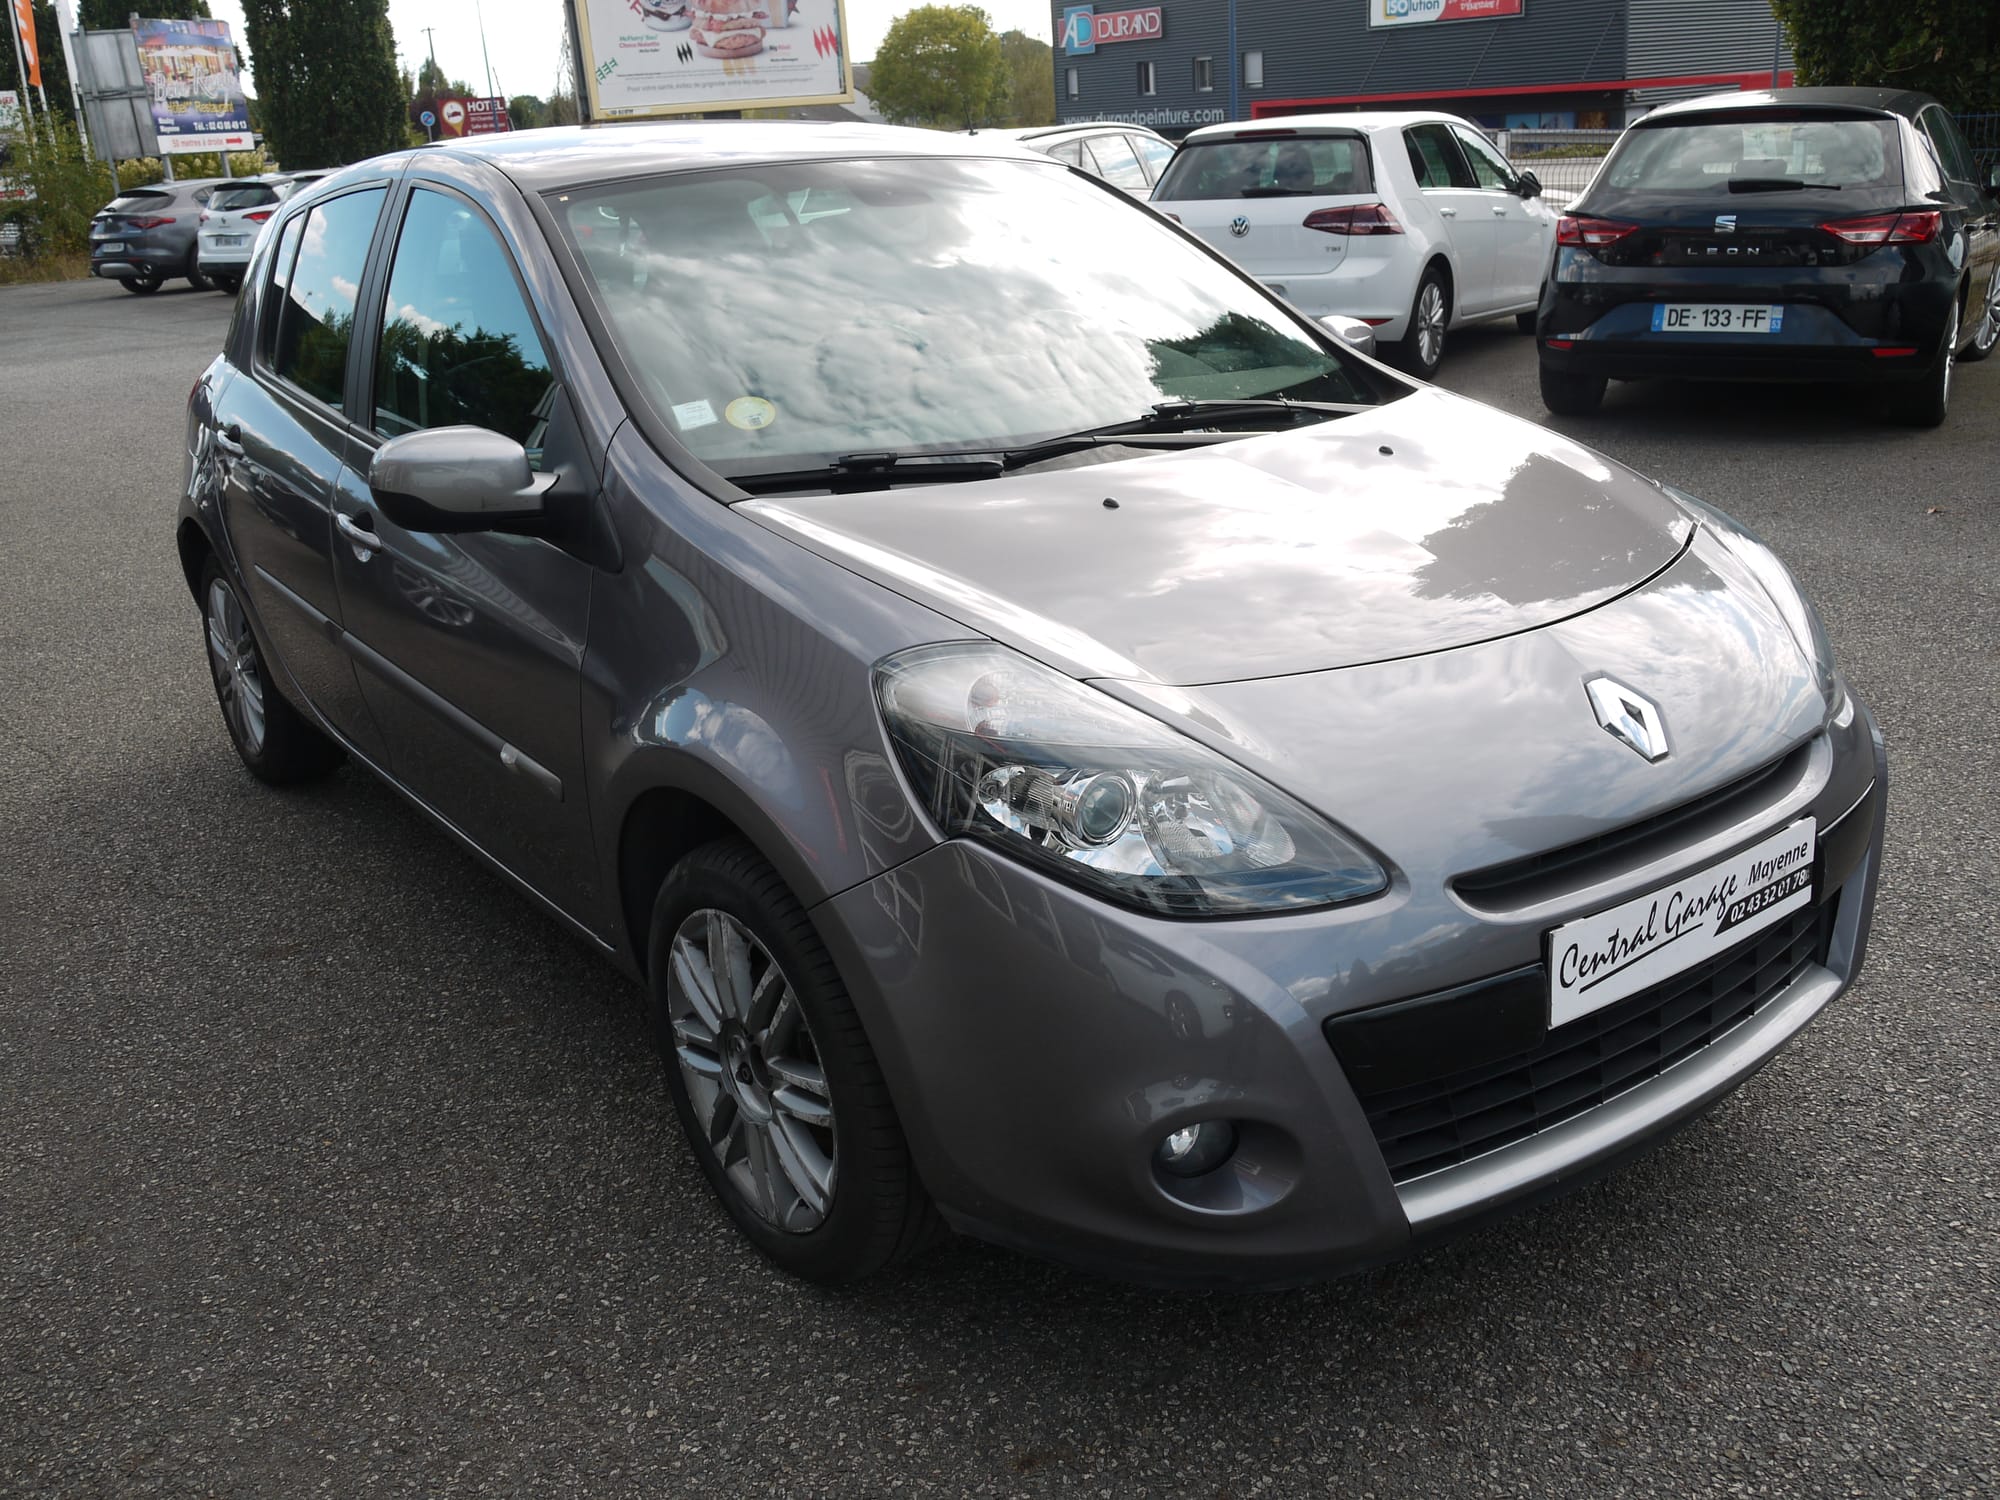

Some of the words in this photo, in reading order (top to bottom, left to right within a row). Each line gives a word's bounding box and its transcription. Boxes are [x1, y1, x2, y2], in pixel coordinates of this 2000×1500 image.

[1098, 12, 1161, 38] DURAND
[466, 100, 504, 112] HOTEL
[1688, 247, 1760, 256] LEON
[1731, 902, 1746, 923] 02
[1746, 893, 1761, 913] 43
[1762, 885, 1777, 906] 32
[1777, 877, 1791, 897] 01
[1792, 868, 1808, 890] 78
[1559, 900, 1658, 988] Central
[1664, 873, 1738, 937] Garage
[1748, 842, 1808, 886] Mayenne
